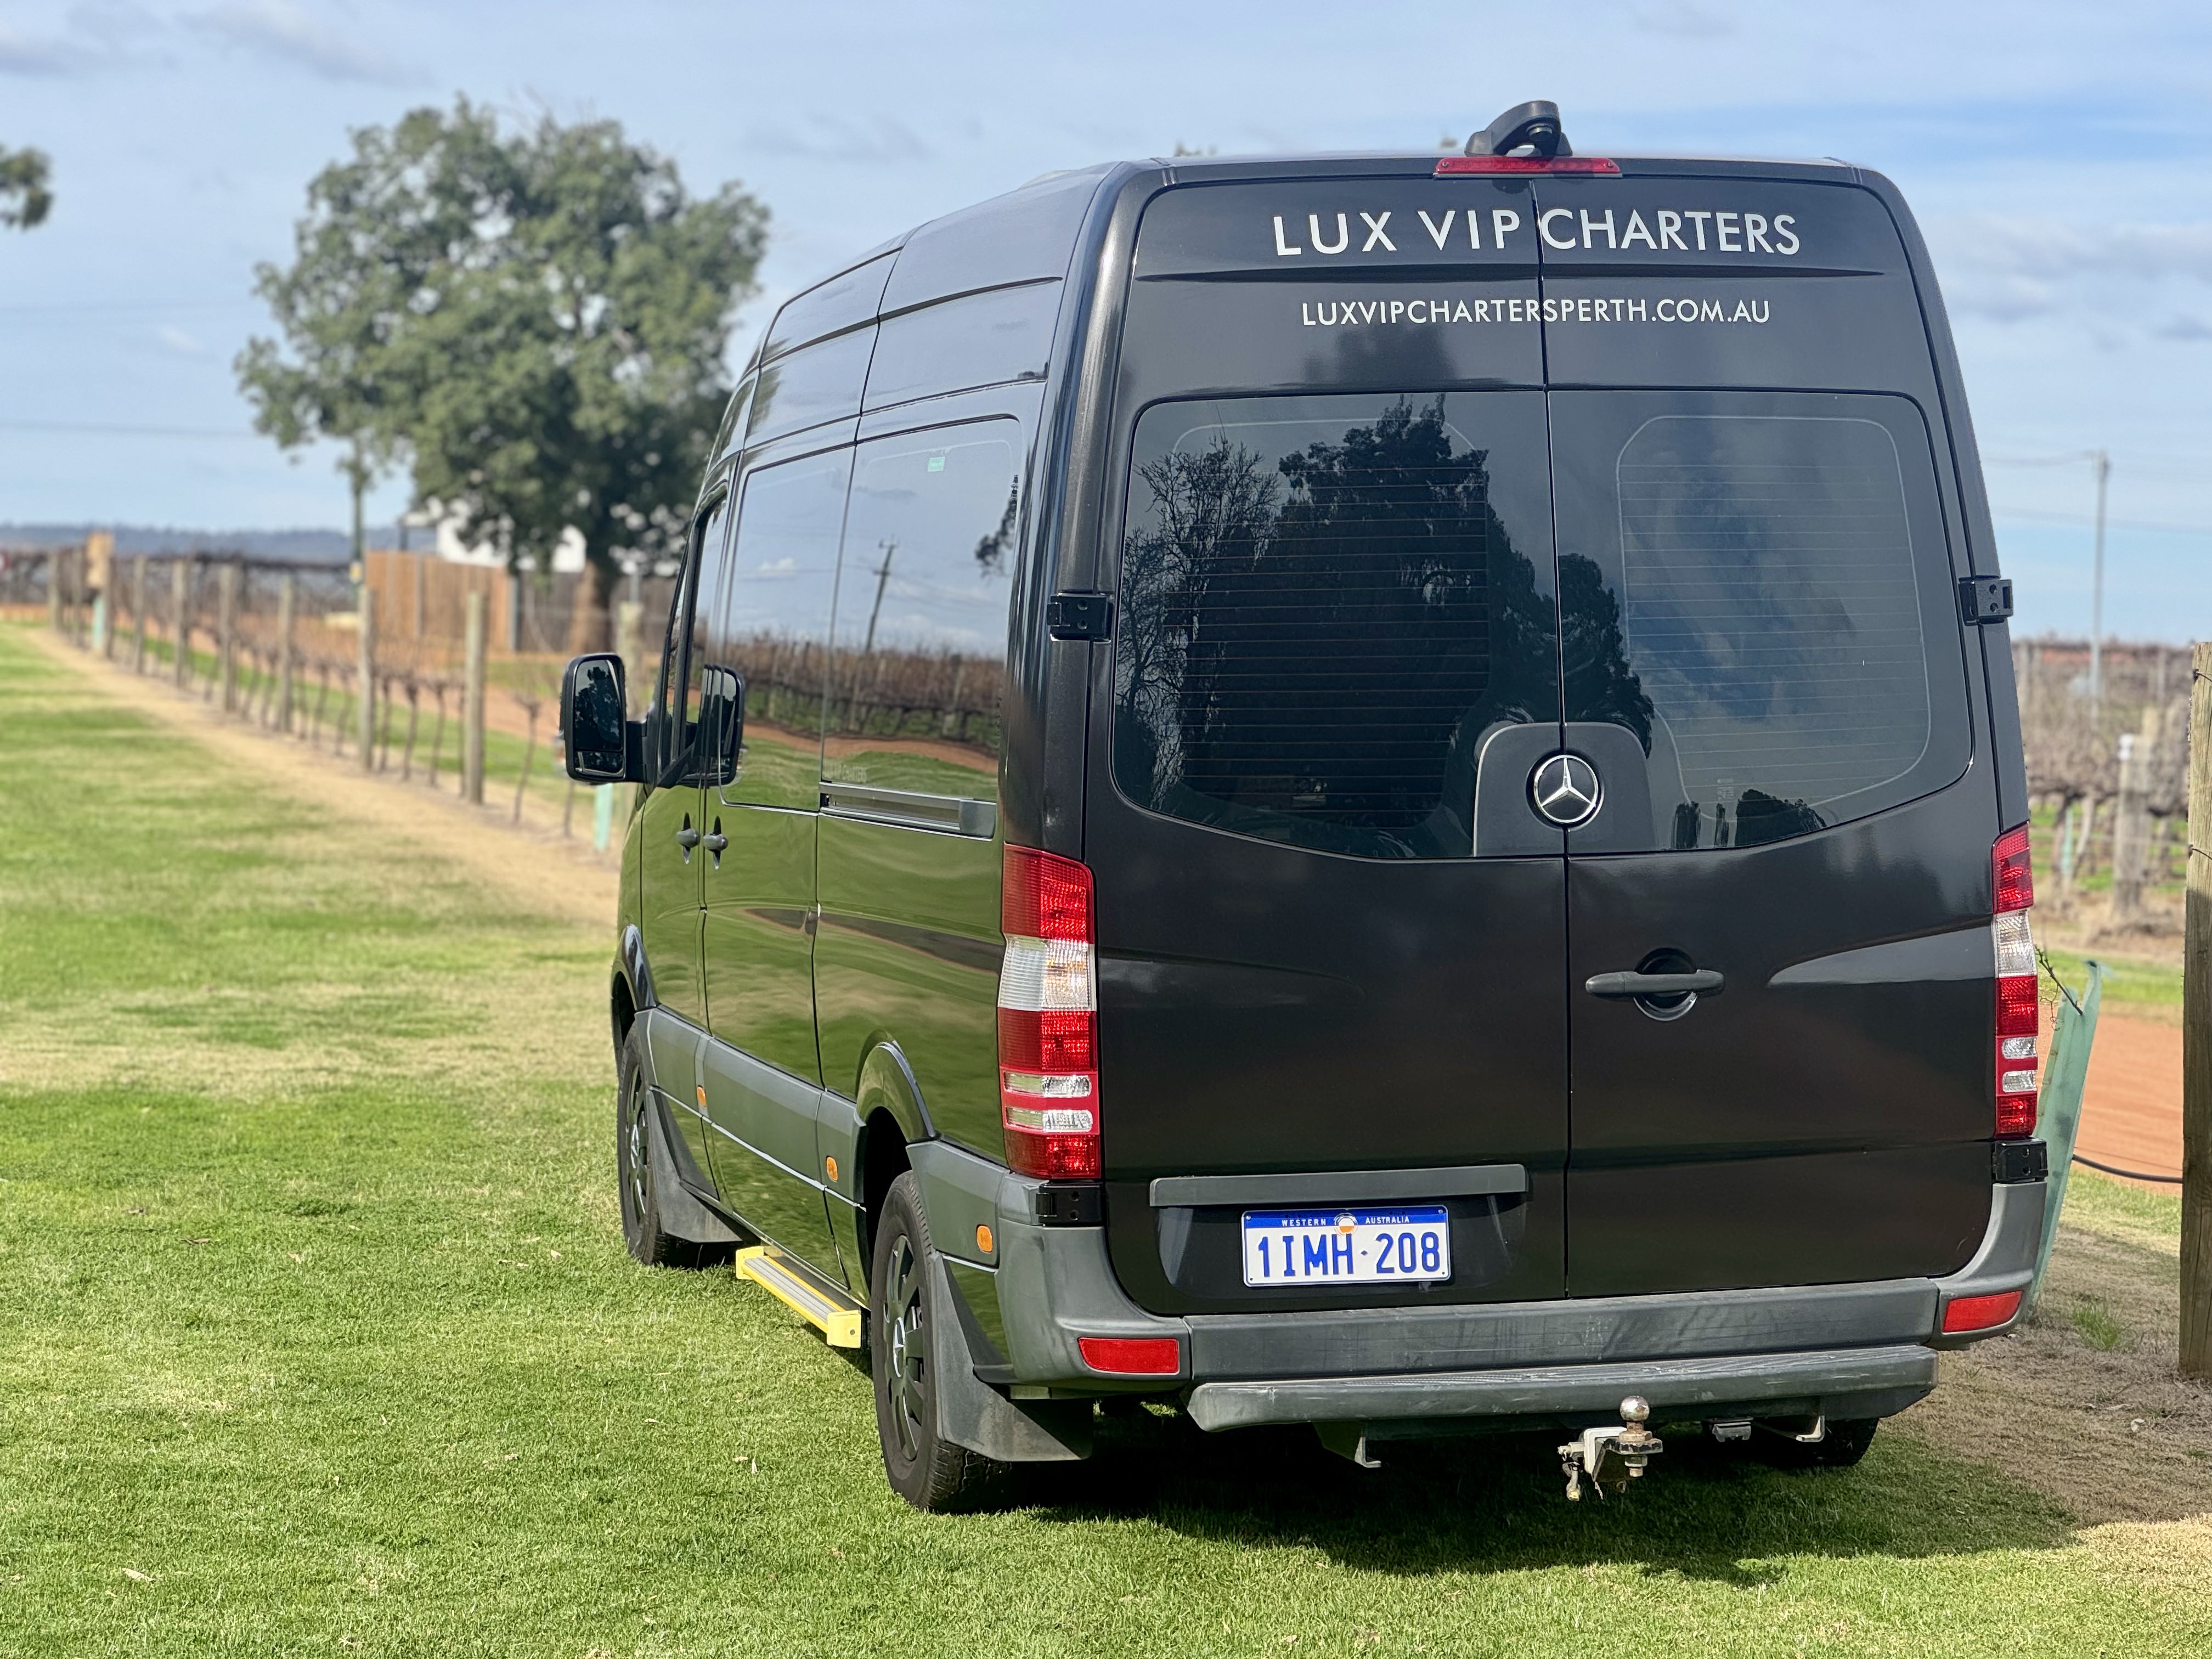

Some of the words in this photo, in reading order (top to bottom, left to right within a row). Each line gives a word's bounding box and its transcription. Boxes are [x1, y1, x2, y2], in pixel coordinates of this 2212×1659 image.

[1273, 211, 1398, 256] LUX
[1417, 209, 1521, 251] VIP
[1539, 208, 1801, 256] CHARTERS
[1302, 298, 1770, 326] LUXVIPCHARTERSPERTH.COM.AU
[1281, 1218, 1327, 1227] WESTERN
[1364, 1215, 1410, 1225] AUSTRALIA
[1375, 1231, 1441, 1274] 208
